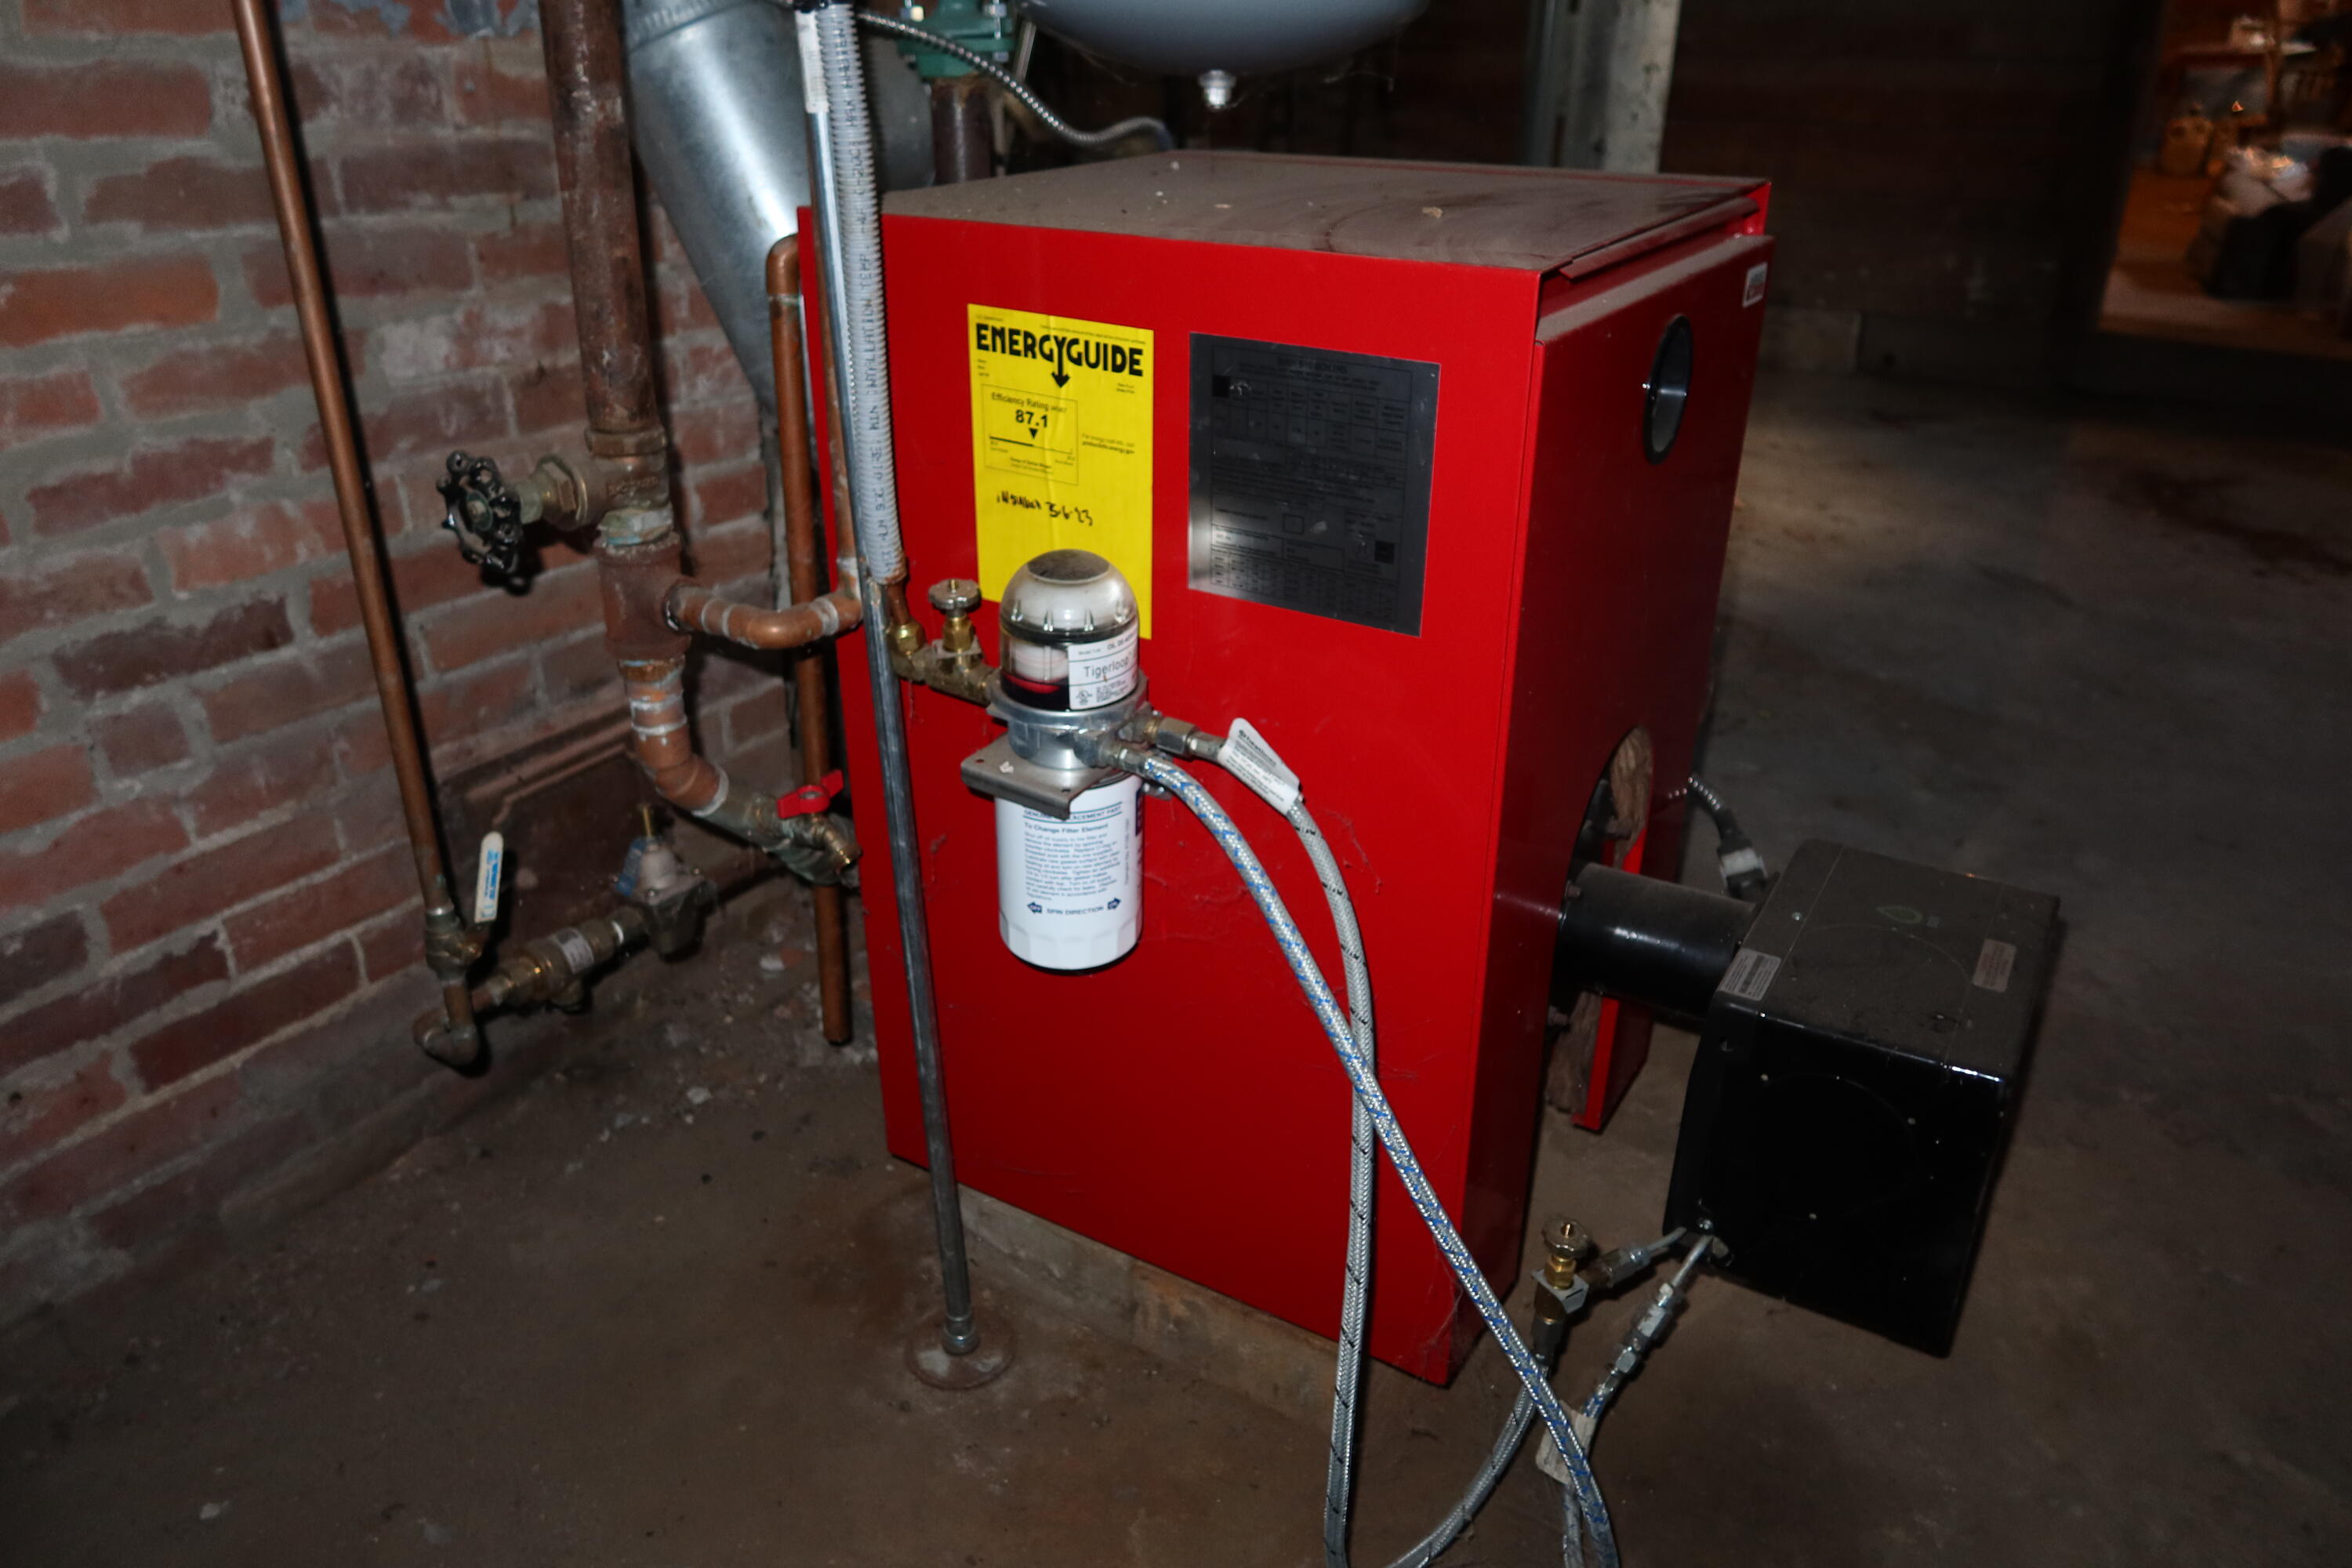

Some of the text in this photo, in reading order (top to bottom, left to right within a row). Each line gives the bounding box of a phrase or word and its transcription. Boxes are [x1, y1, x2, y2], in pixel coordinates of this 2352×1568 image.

[976, 322, 1144, 378] ENERGYGUIDE
[1026, 398, 1049, 412] Rating
[1015, 408, 1048, 428] 87.1
[1083, 656, 1129, 679] Tigerloop
[1065, 906, 1104, 915] DIRECTION
